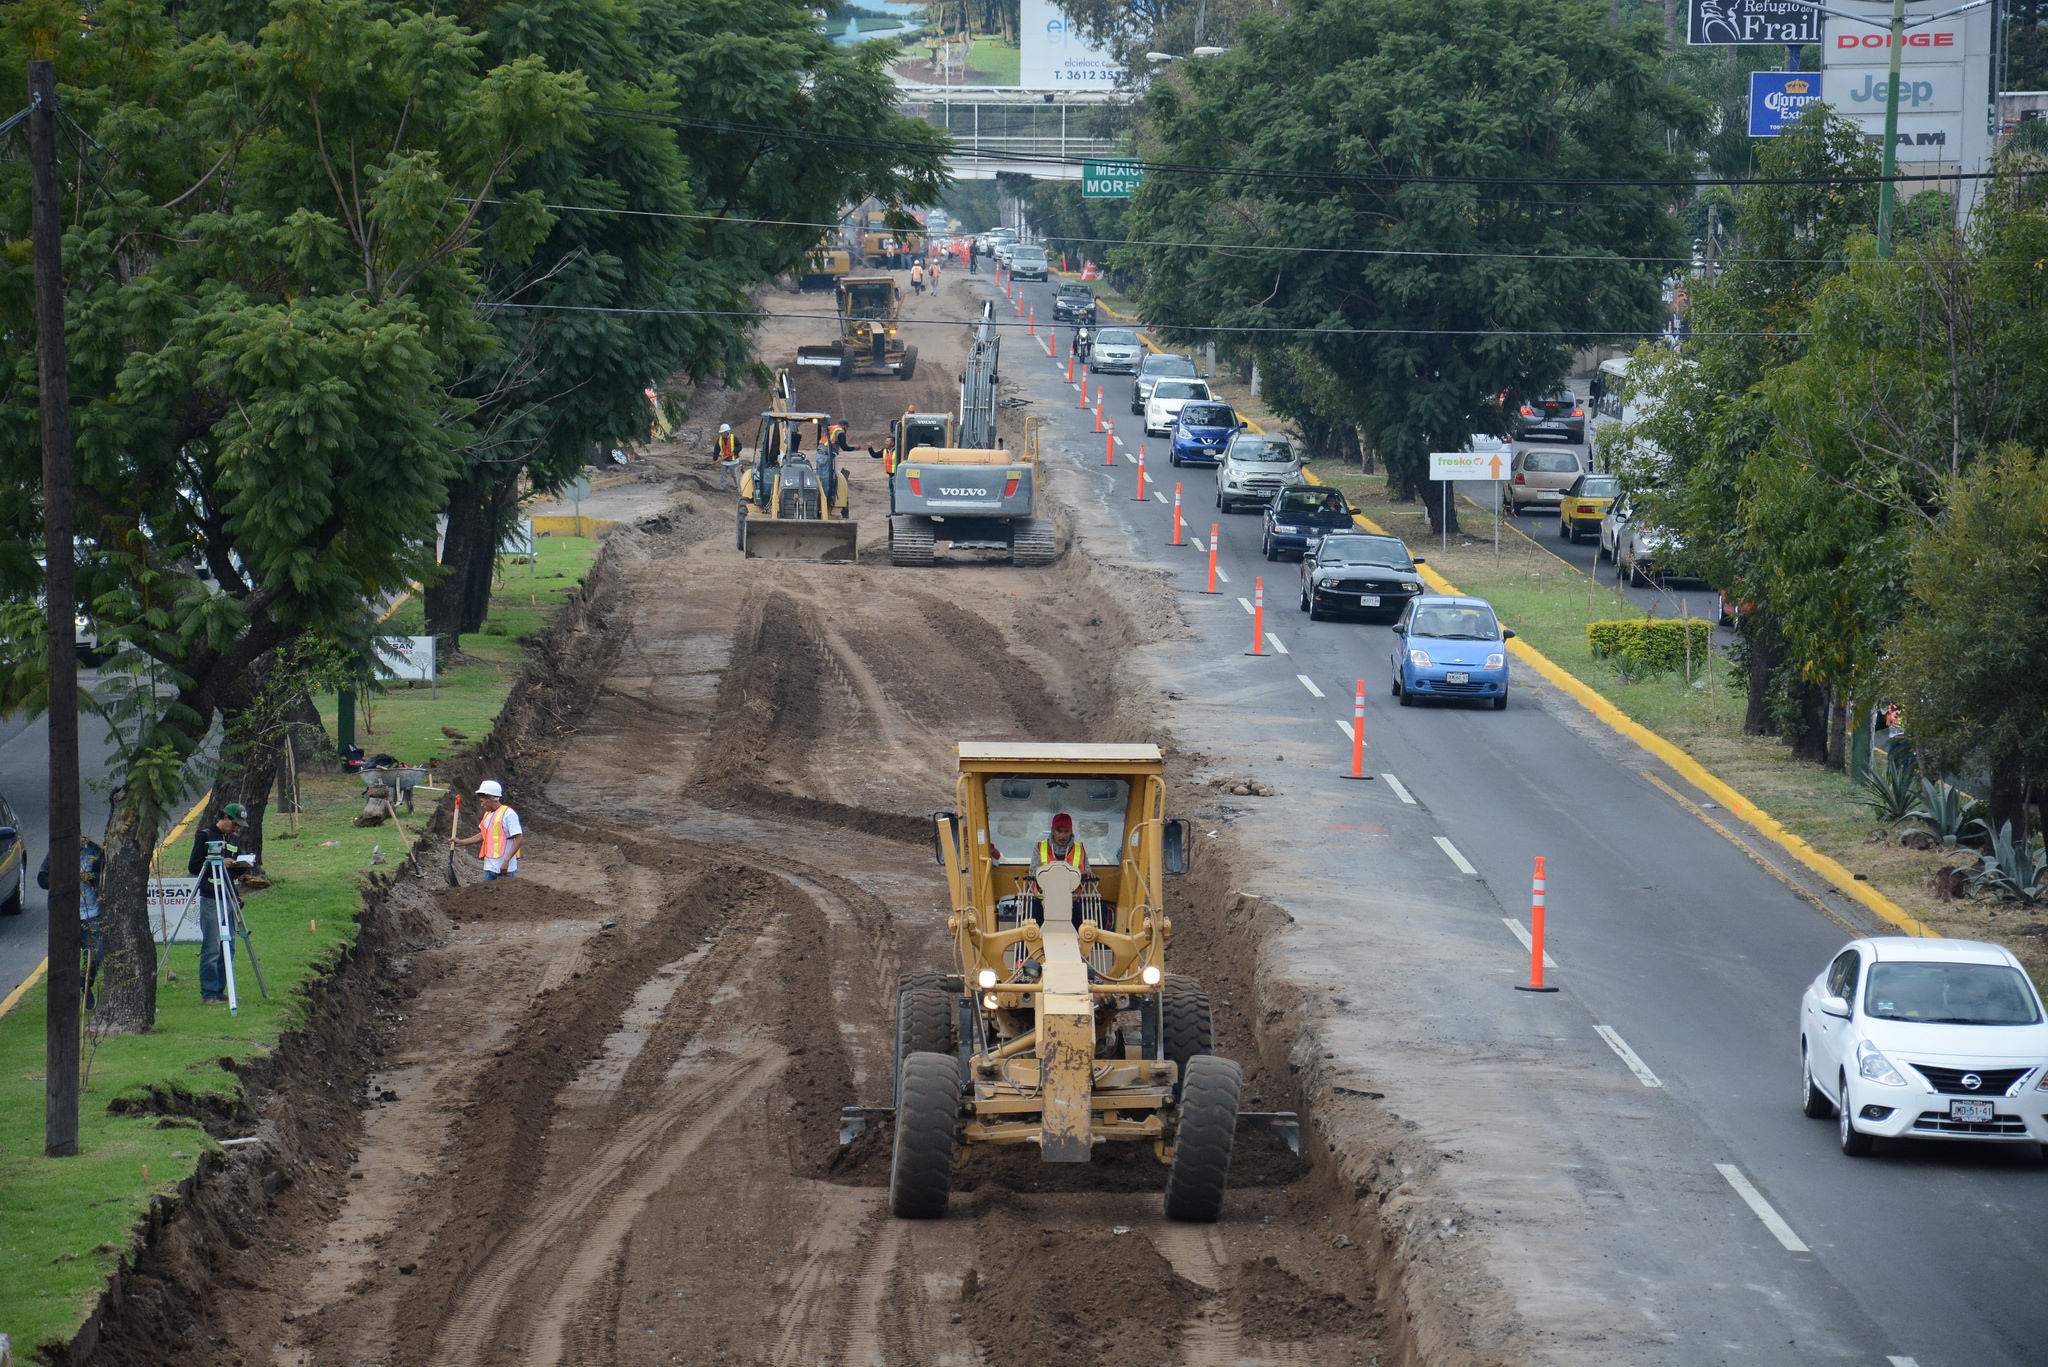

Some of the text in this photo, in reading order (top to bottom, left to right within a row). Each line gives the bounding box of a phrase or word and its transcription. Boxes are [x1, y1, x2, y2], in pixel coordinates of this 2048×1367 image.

[1744, 0, 1800, 14] Refugio
[1741, 9, 1822, 40] Frail
[1837, 33, 1954, 49] DODGE
[1066, 70, 1096, 80] 3612
[1851, 74, 1933, 107] Jeep
[1087, 180, 1141, 193] MORE
[939, 487, 987, 496] VOLVO
